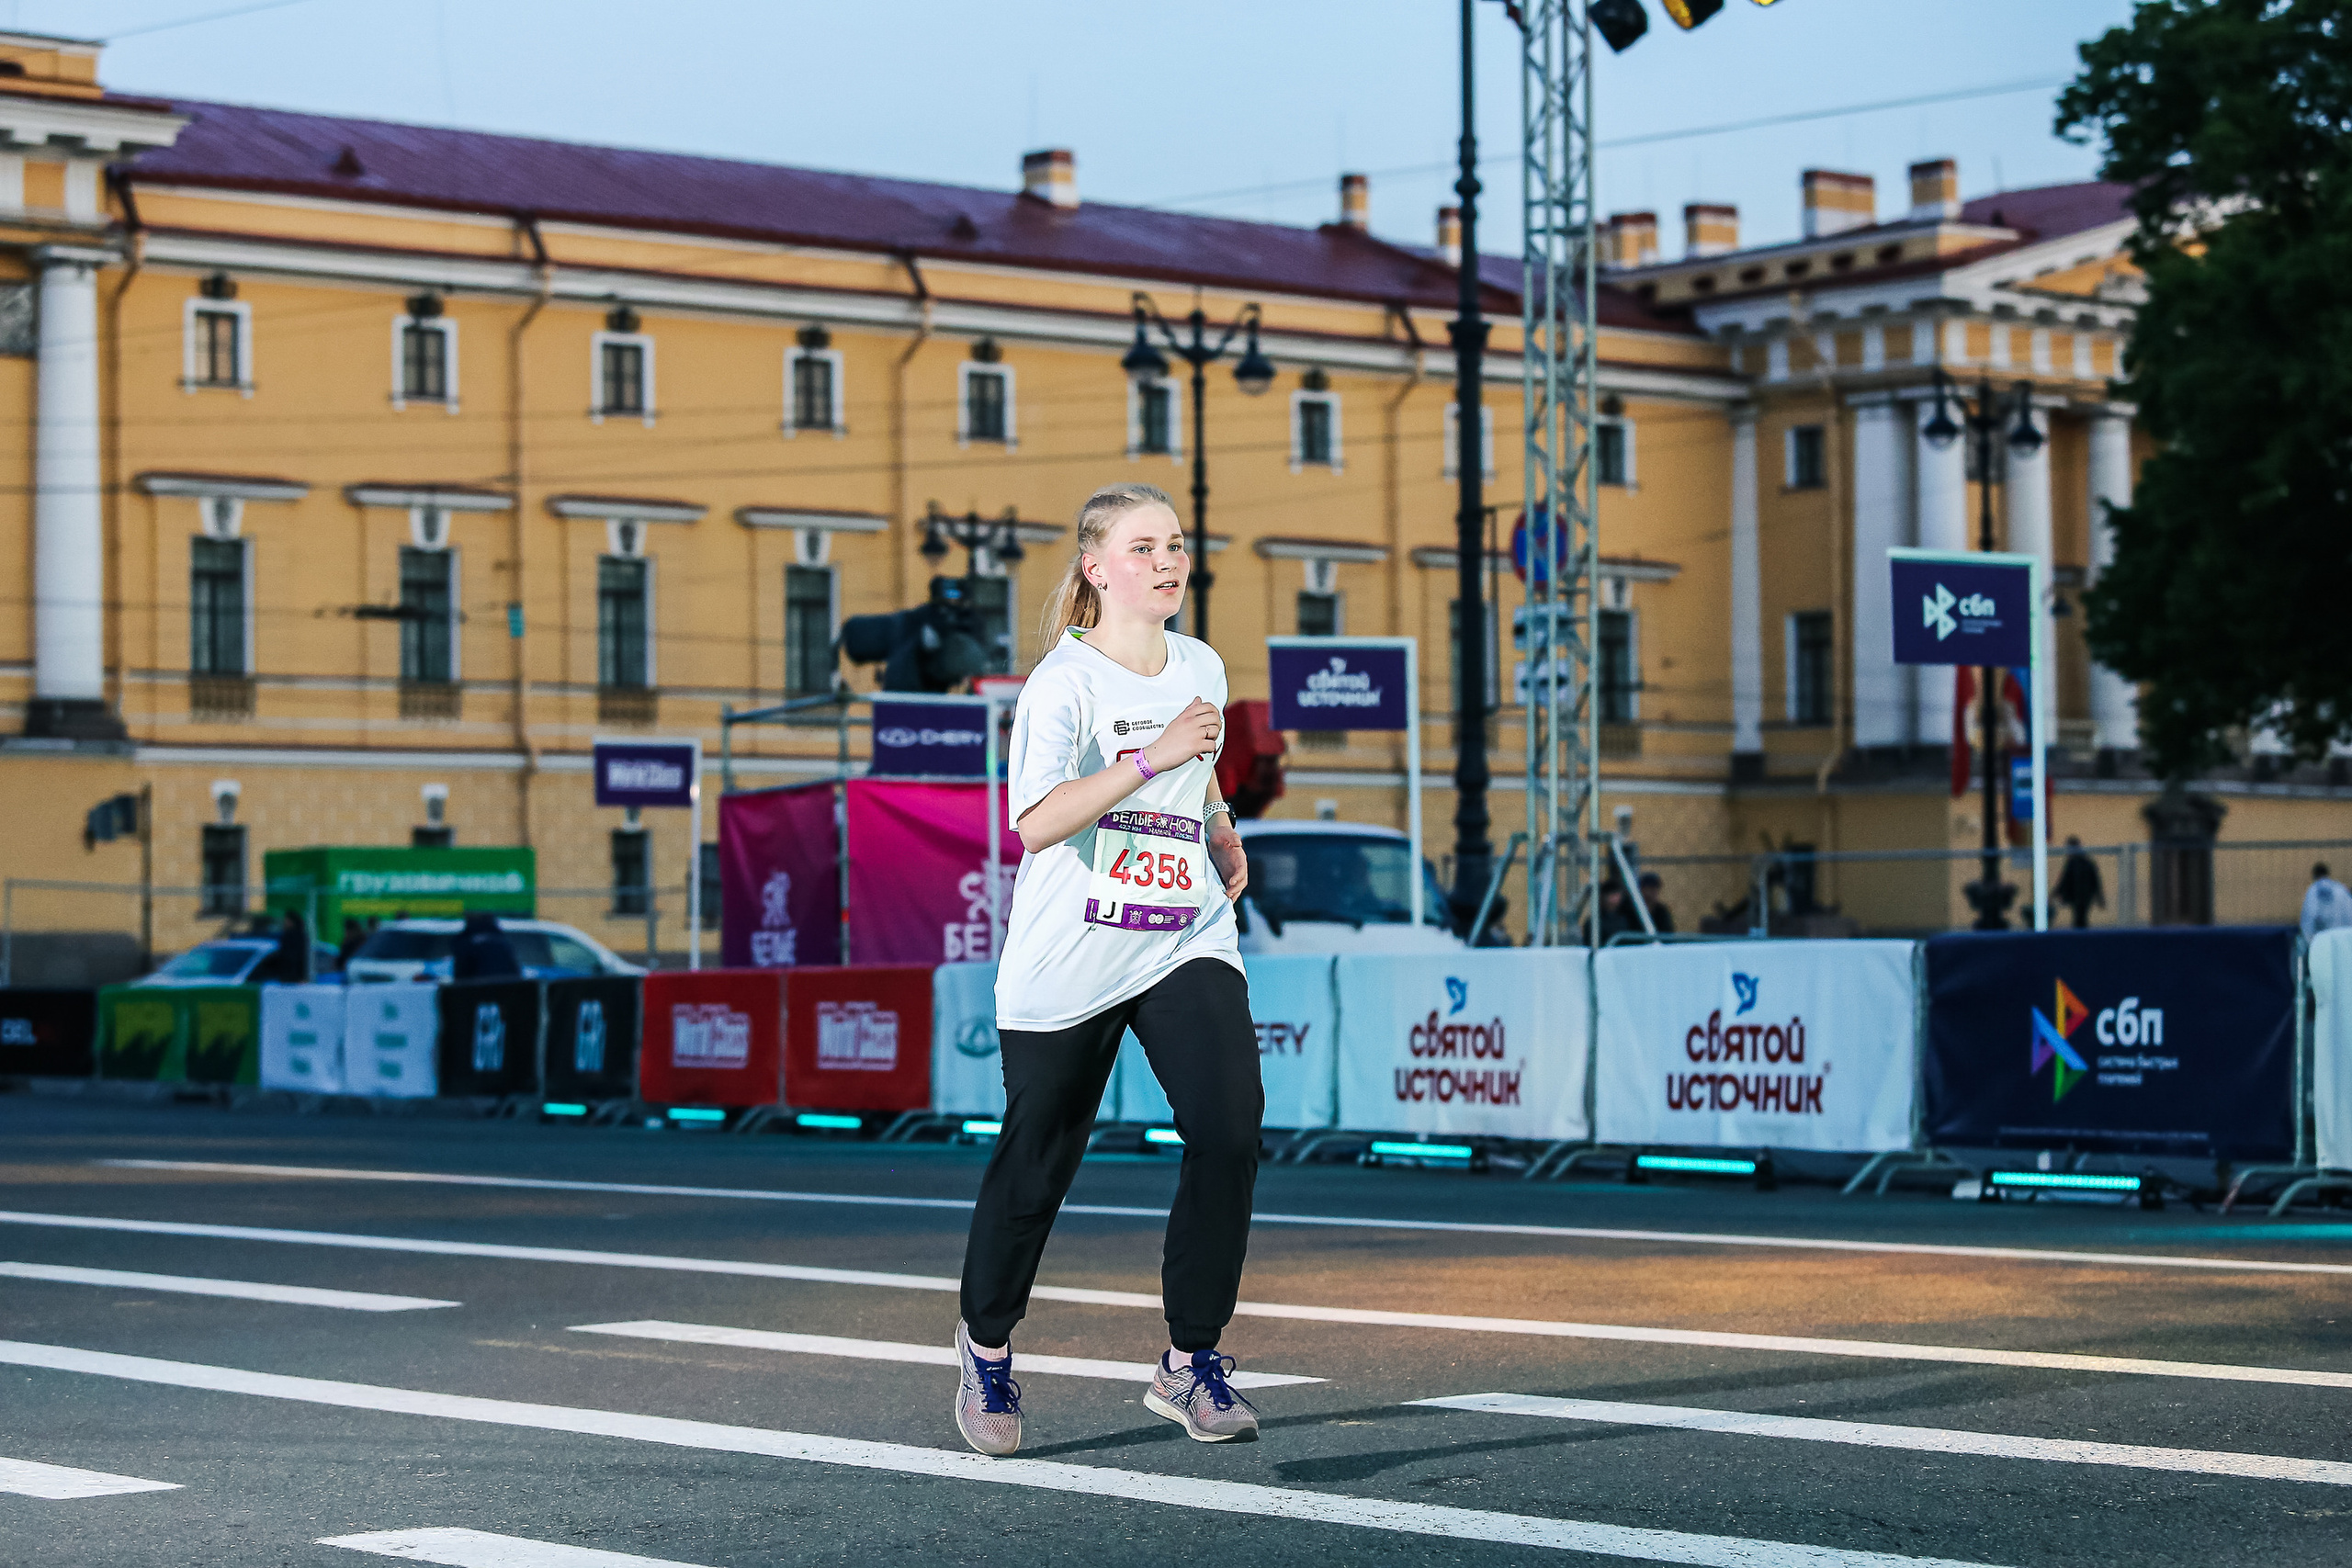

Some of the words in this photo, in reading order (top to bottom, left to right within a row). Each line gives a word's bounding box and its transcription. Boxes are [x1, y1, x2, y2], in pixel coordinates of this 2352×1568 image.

[1109, 848, 1192, 890] 4358
[1102, 901, 1116, 919] J
[1253, 1021, 1310, 1055] ERY
[1409, 1008, 1505, 1059] святой
[1685, 1008, 1804, 1063] святой
[2096, 996, 2164, 1046] сбп
